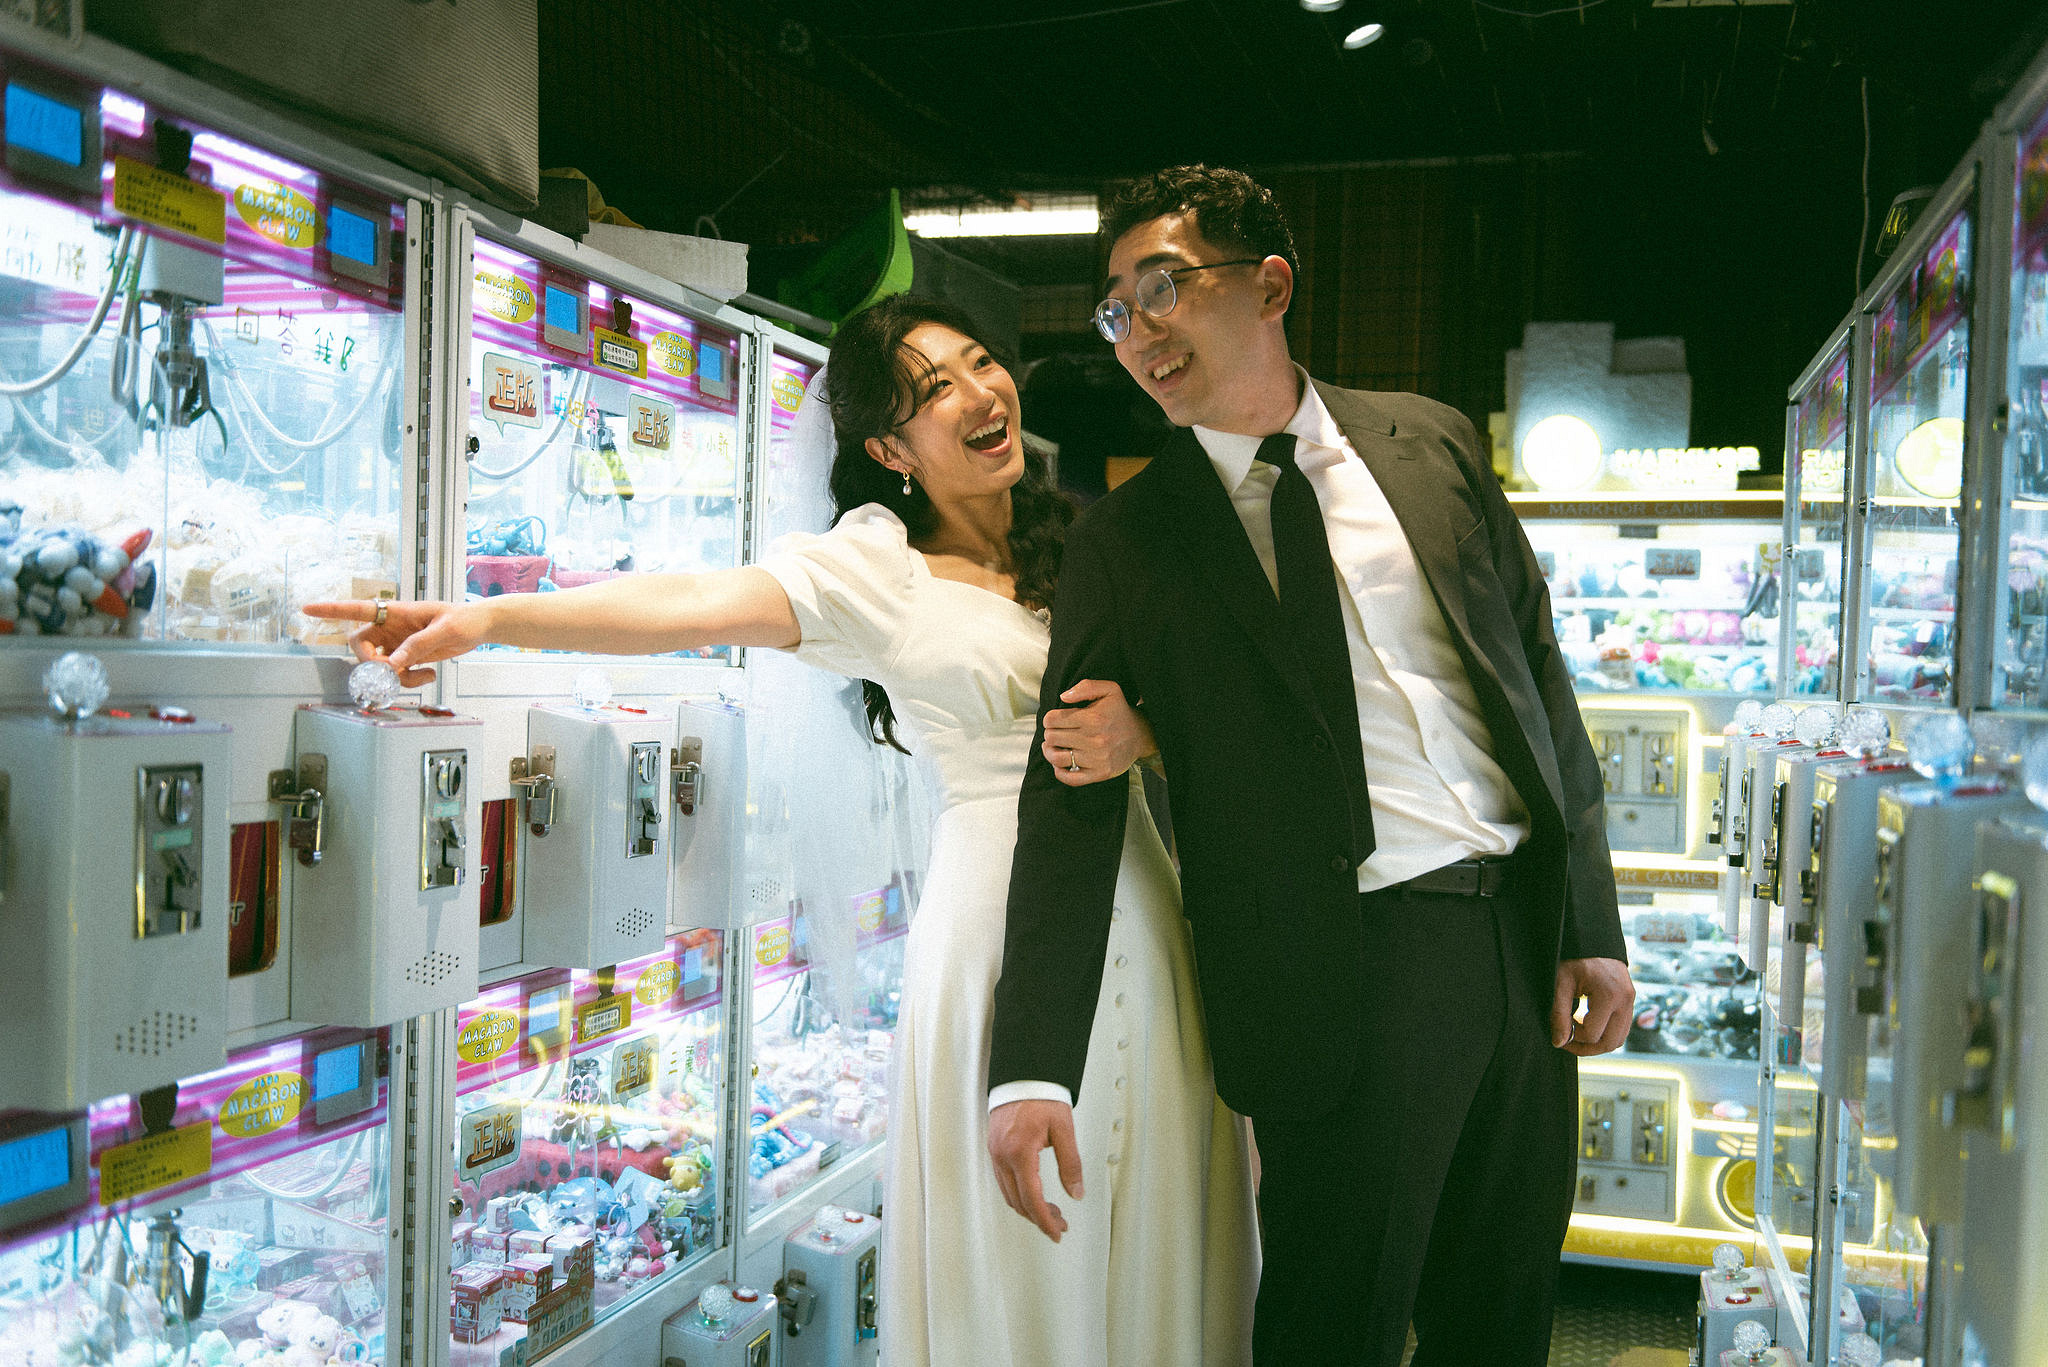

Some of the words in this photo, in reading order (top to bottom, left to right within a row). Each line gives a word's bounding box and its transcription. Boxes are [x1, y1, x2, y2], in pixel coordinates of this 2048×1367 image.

[242, 187, 316, 227] MACARON
[258, 214, 301, 241] CLAW
[480, 275, 530, 305] MACARON
[655, 338, 693, 361] MACARON
[663, 356, 684, 373] CLAW
[493, 366, 537, 414] 正版
[634, 405, 671, 447] 正版
[1549, 502, 1647, 515] MARKHOR
[1655, 502, 1724, 515] GAMES
[1646, 871, 1715, 884] GAMES
[640, 968, 677, 989] MACARON
[647, 984, 669, 1001] CLAW
[463, 1017, 514, 1045] MACARON
[474, 1036, 504, 1058] CLAW
[619, 1046, 654, 1090] 正版
[228, 1080, 300, 1117] MACARON
[244, 1104, 285, 1131] CLAW
[471, 1112, 515, 1164] 正版
